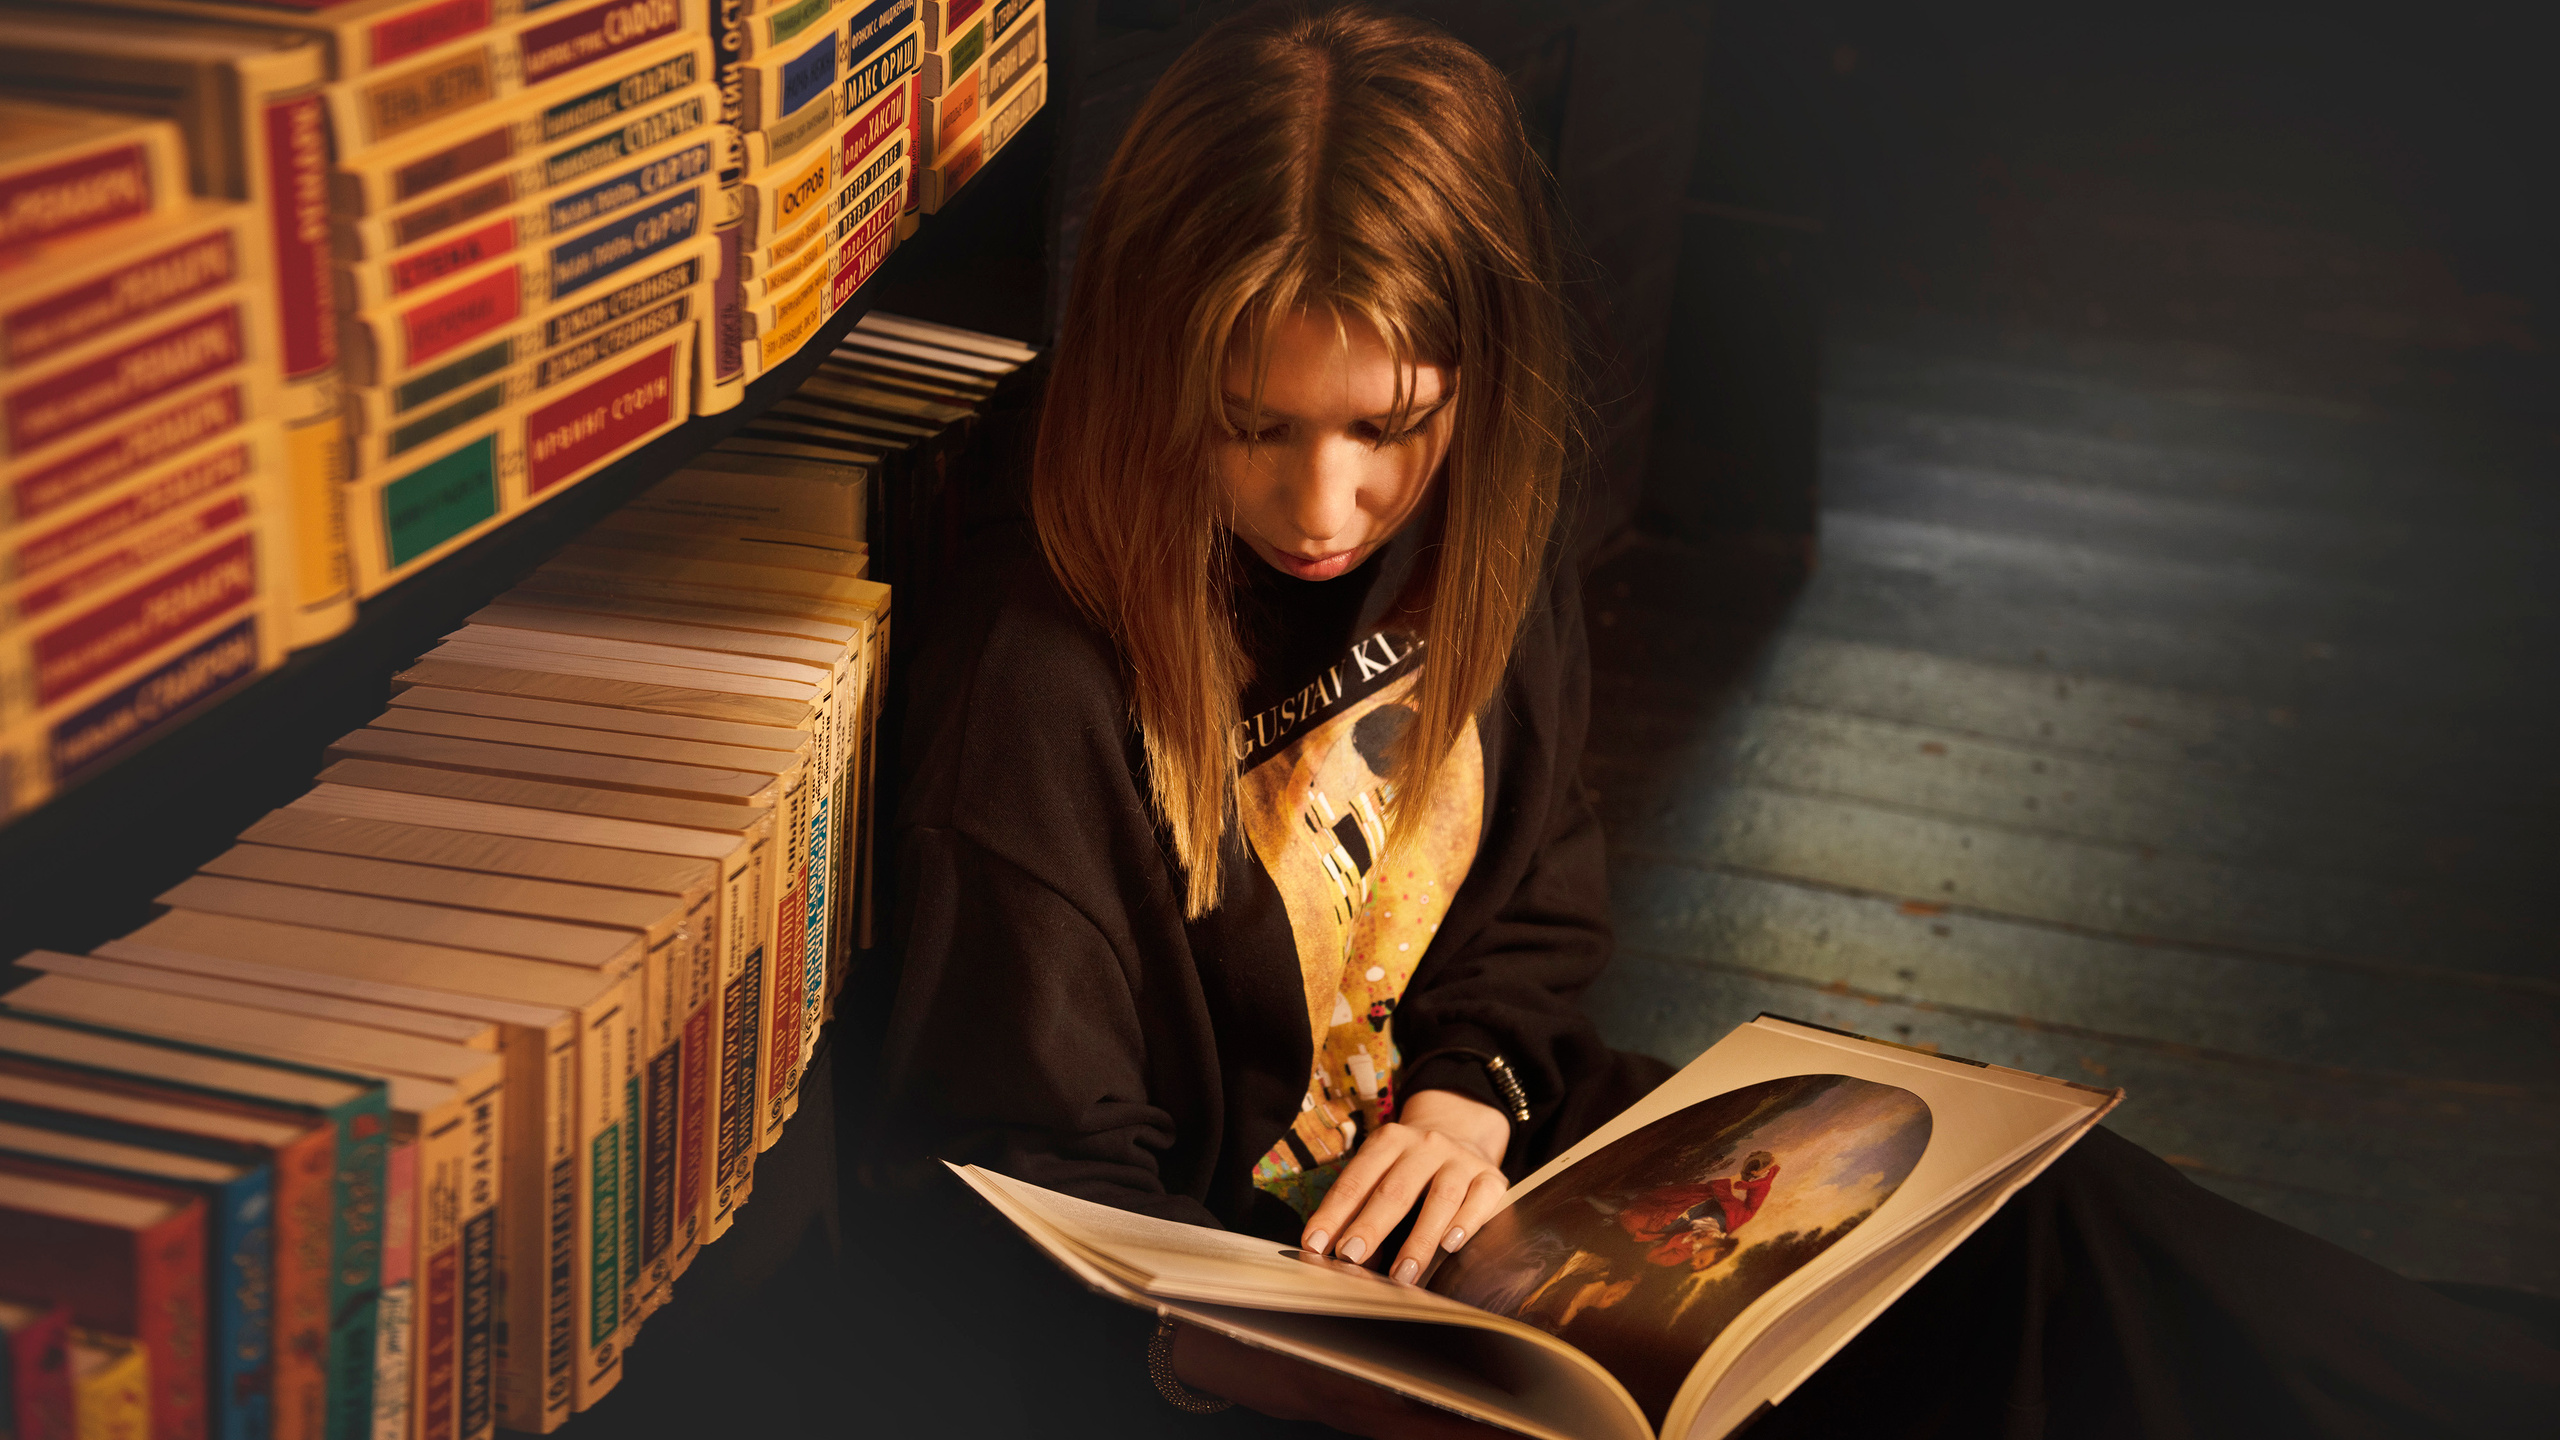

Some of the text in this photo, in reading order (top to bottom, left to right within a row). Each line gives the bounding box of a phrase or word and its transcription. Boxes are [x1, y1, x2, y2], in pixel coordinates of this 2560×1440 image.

[848, 64, 878, 110] МАКС
[881, 39, 914, 85] ФРИШ
[844, 93, 902, 166] ОЛДОС ХАКСЛИ
[783, 166, 824, 214] ОСТРОВ
[843, 173, 898, 235] ПЕТЕР ХАНДКЕ
[844, 145, 898, 205] ПЕТЕР ХАНДКЕ
[835, 226, 893, 304] ОЛДОС ХАКСЛИ
[842, 189, 900, 264] ОЛДОС ХАКСЛИ
[1232, 658, 1346, 760] GUSTAV
[806, 823, 819, 1001] ЭЛЬЧИН САФАРЛИ
[815, 805, 827, 982] ЭЛЬЧИН САФАРЛИ
[773, 900, 794, 1090] ЗАХАР ПРИЛЕПИН
[788, 874, 805, 1061] ЗАХАР ПРИЛЕПИН
[719, 984, 741, 1180] МАЙЯ КУЧЕРСКАЯ
[738, 1066, 754, 1148] ВИКТОР
